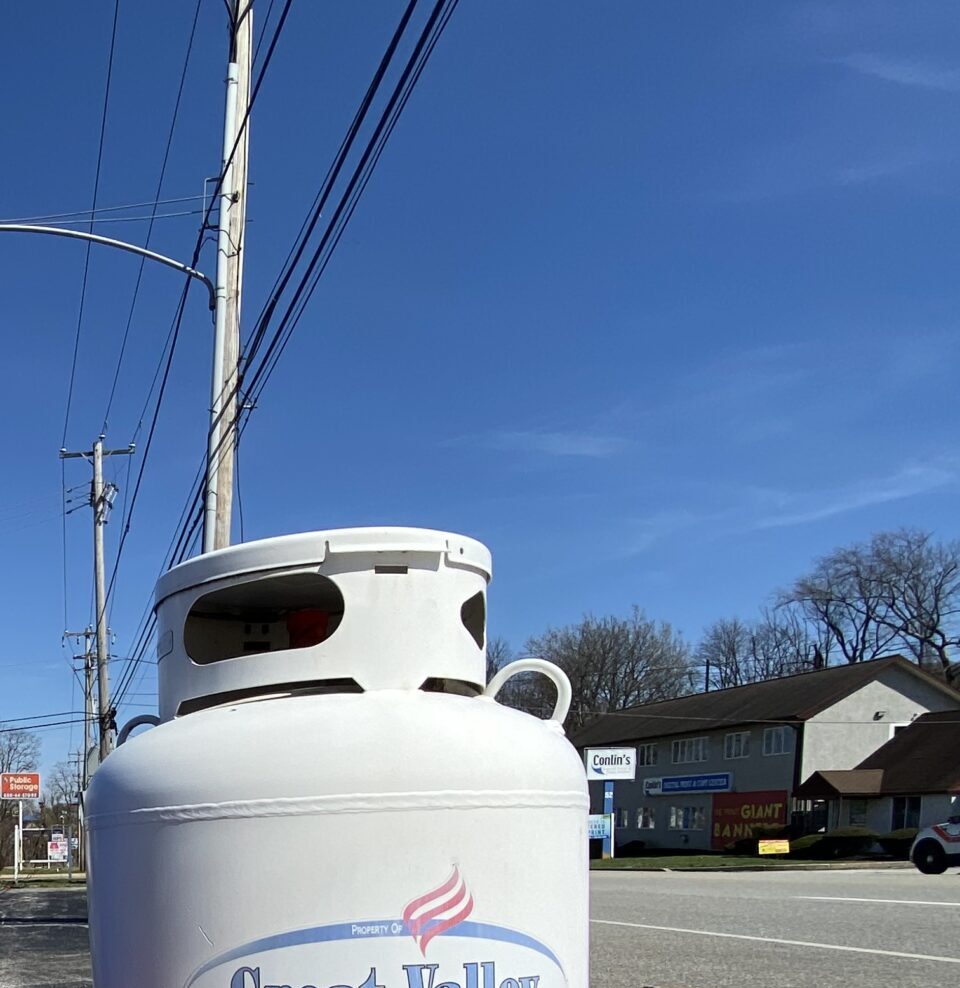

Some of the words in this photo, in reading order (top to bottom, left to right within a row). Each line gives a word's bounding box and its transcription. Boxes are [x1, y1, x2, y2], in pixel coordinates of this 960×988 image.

[593, 754, 631, 766] Conlin's
[9, 776, 32, 784] Public
[9, 783, 39, 792] Storage
[741, 803, 783, 819] GIANT
